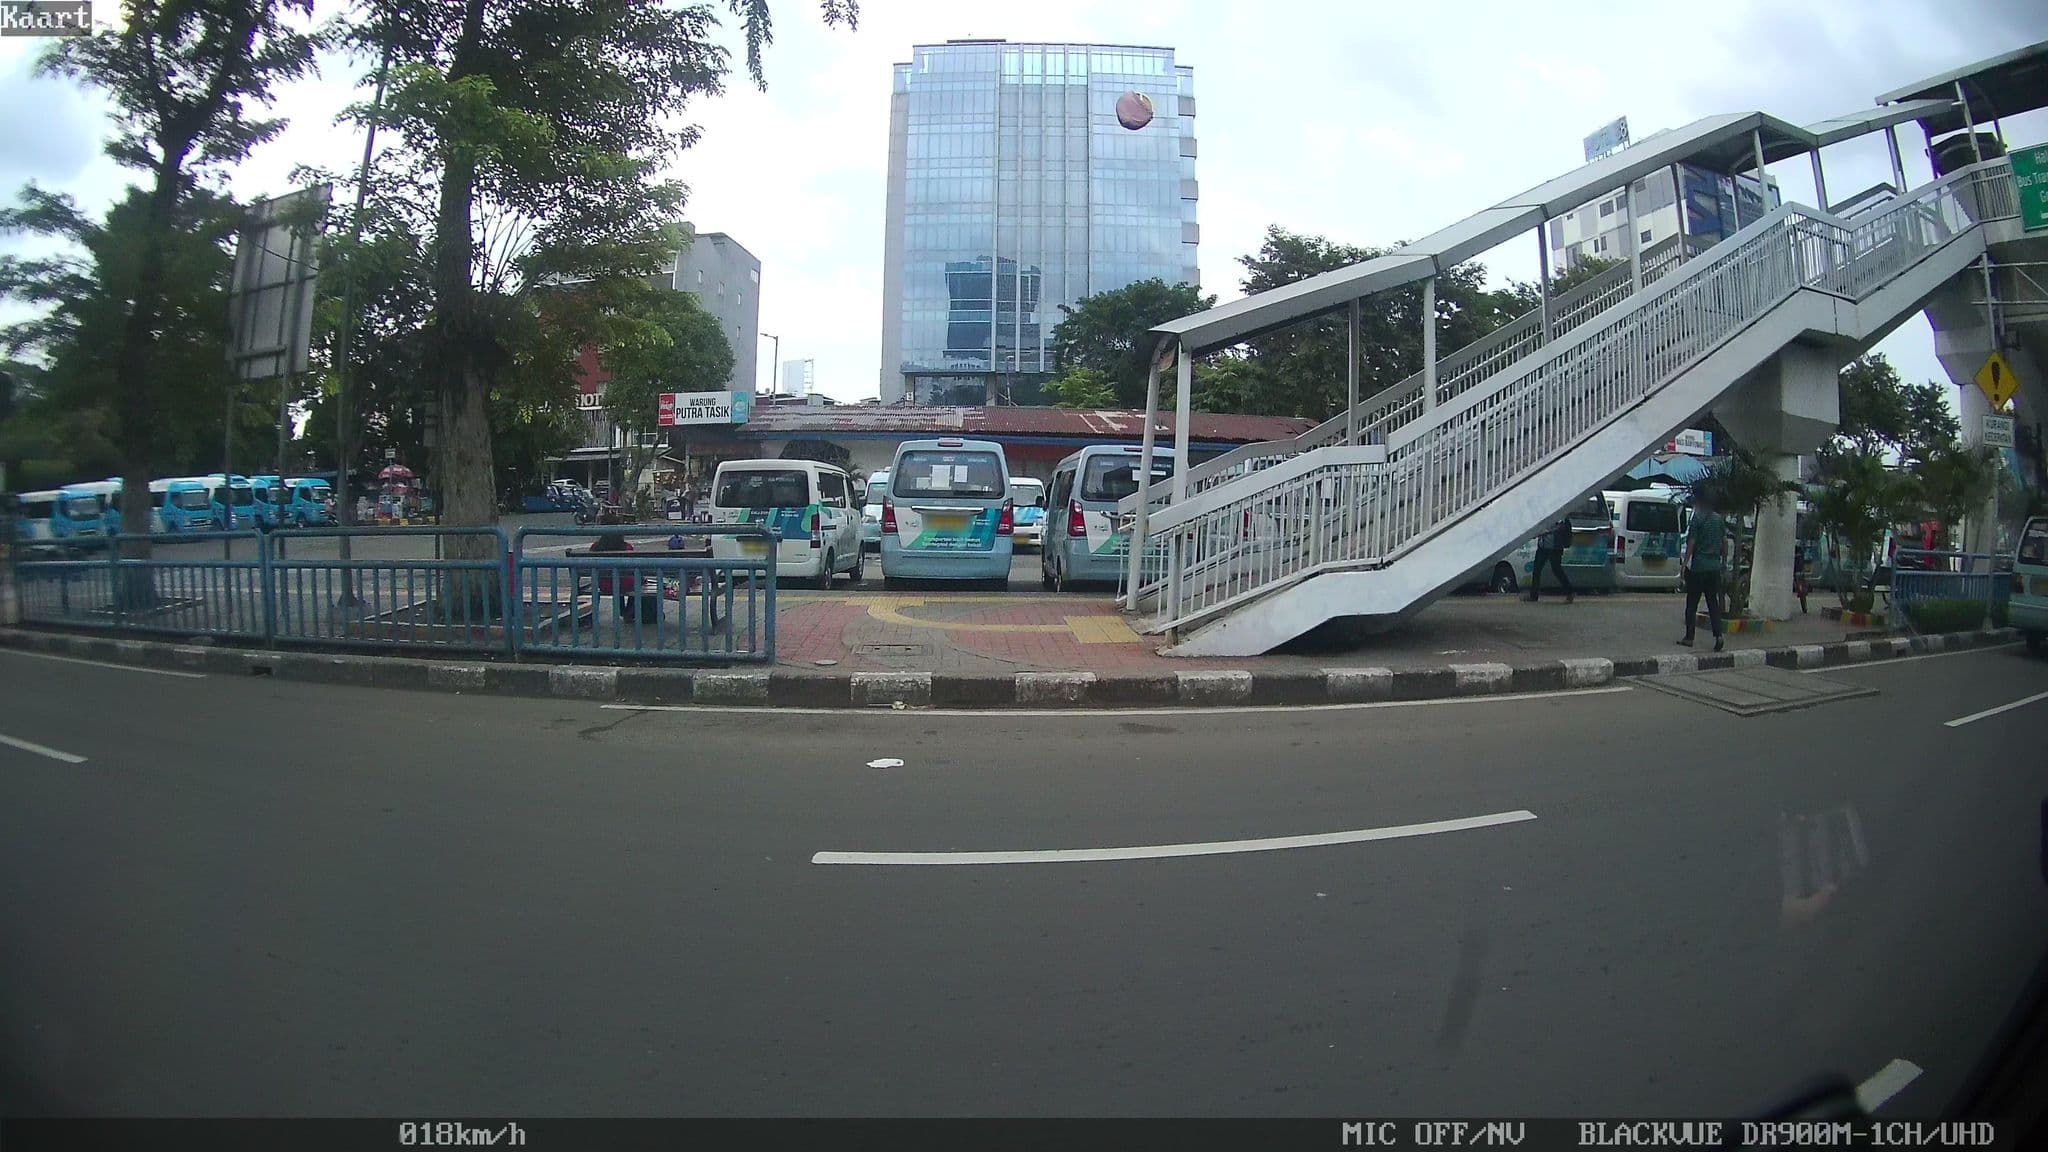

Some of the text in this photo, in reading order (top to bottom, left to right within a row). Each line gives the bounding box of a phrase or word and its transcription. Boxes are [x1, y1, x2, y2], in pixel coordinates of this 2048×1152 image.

[2016, 172, 2048, 188] Bus Tra
[689, 397, 717, 407] WARUNG
[675, 407, 703, 419] PUTRA
[704, 406, 730, 418] TASIK
